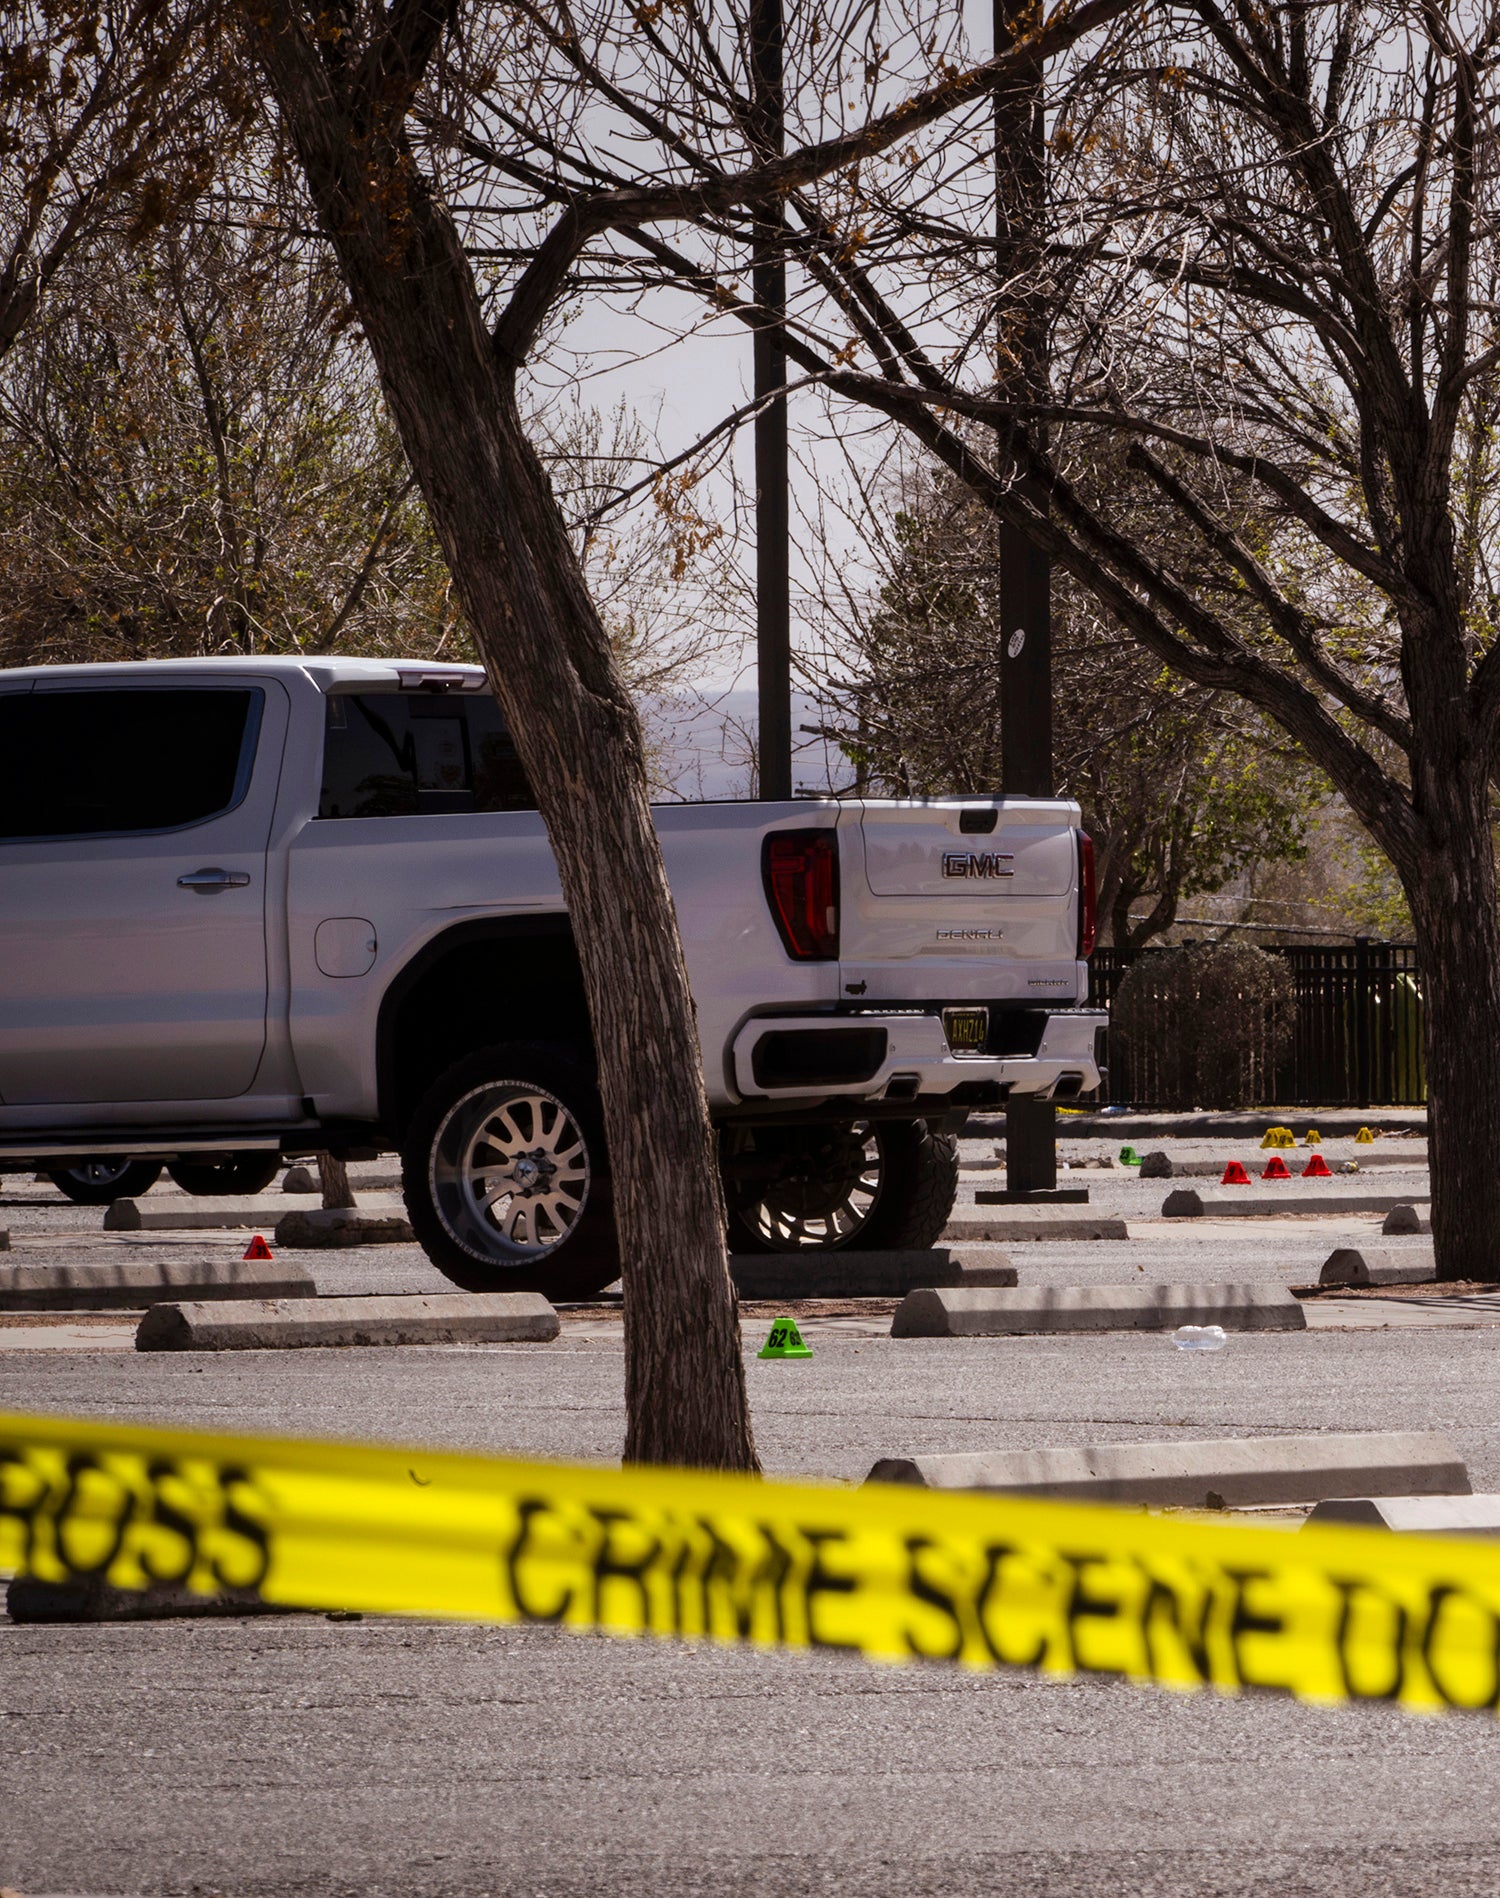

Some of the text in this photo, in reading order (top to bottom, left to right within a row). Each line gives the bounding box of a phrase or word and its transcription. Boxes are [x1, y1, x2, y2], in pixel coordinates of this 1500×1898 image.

[943, 852, 1015, 879] GMC
[936, 928, 1004, 940] DENALI
[768, 1328, 788, 1348] 62
[507, 1492, 867, 1648] CRIME
[903, 1532, 1294, 1690] SCENE
